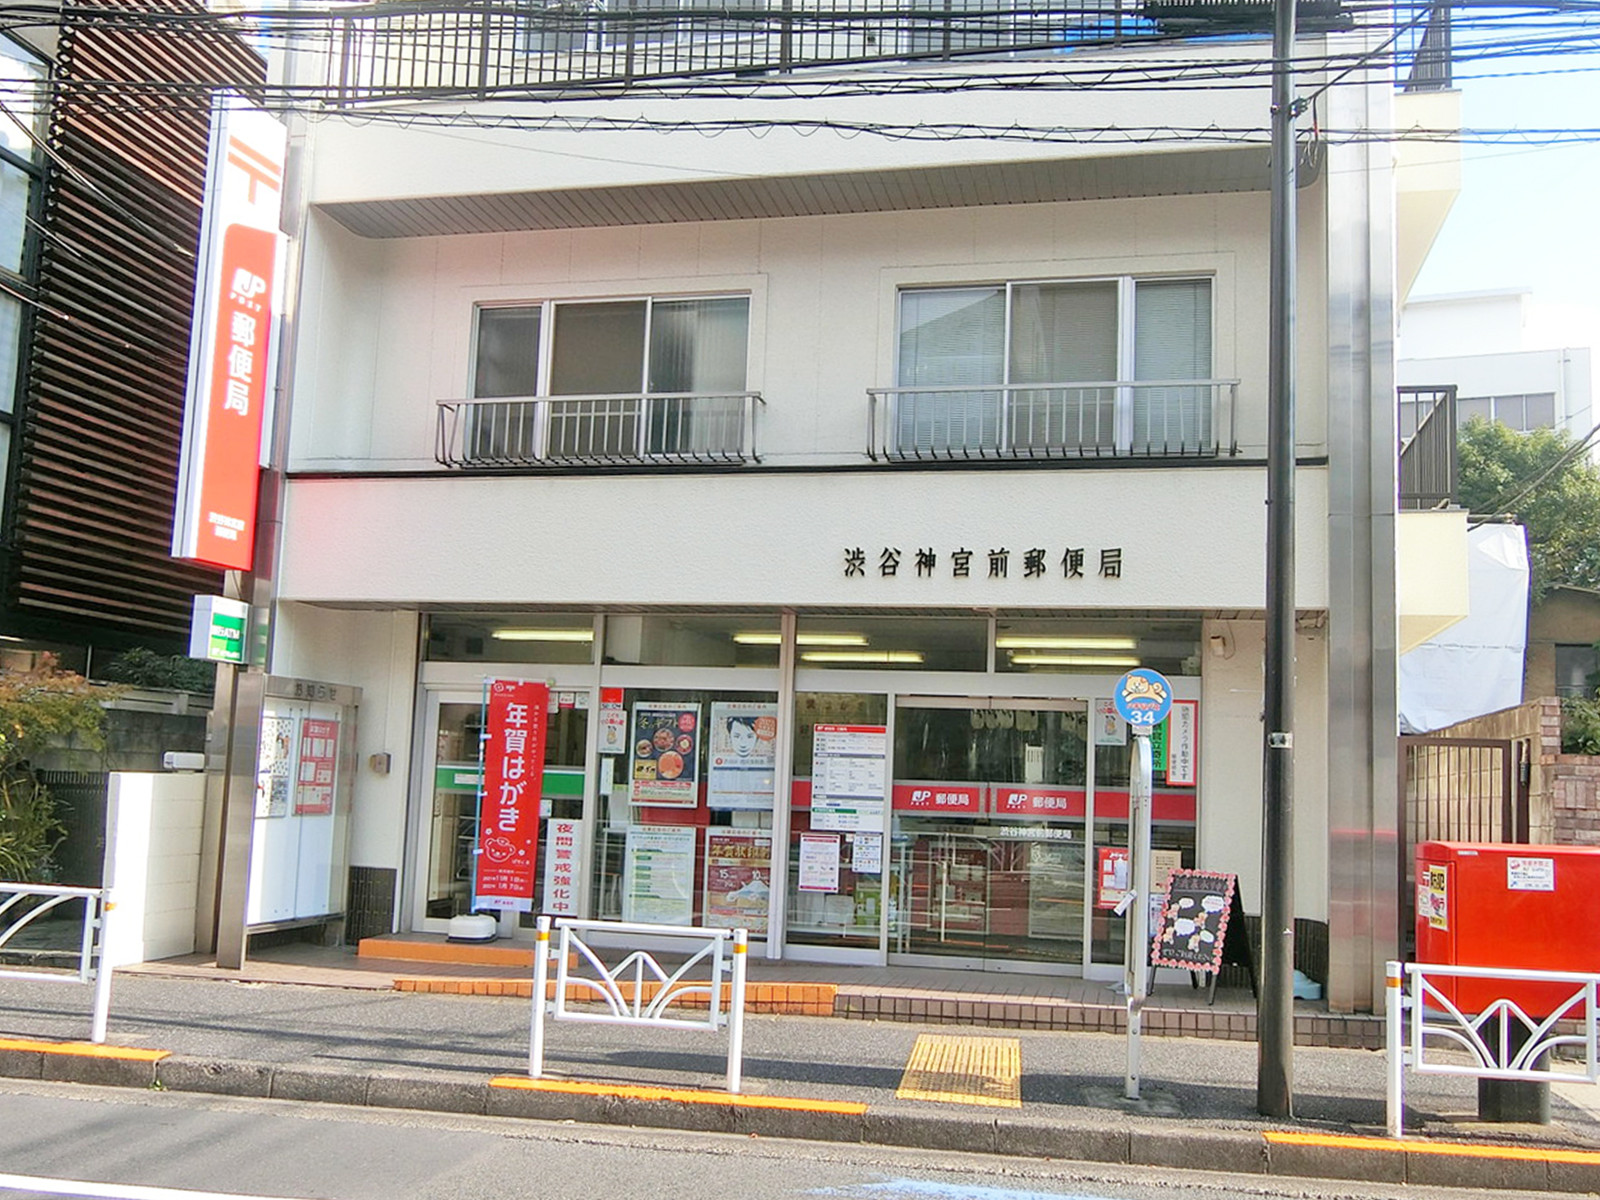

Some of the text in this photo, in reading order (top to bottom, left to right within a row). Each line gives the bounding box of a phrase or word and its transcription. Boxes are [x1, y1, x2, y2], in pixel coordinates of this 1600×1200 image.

[224, 311, 256, 416] 郵便局
[843, 547, 1123, 579] 渋谷神宮前郵便局
[294, 683, 338, 701] お知らせ
[1130, 710, 1156, 724] 34
[498, 702, 529, 832] 年賀はがき
[935, 793, 970, 806] 郵便局
[1032, 796, 1067, 810] 郵便局
[999, 826, 1072, 840] 渋谷神宮前郵便局
